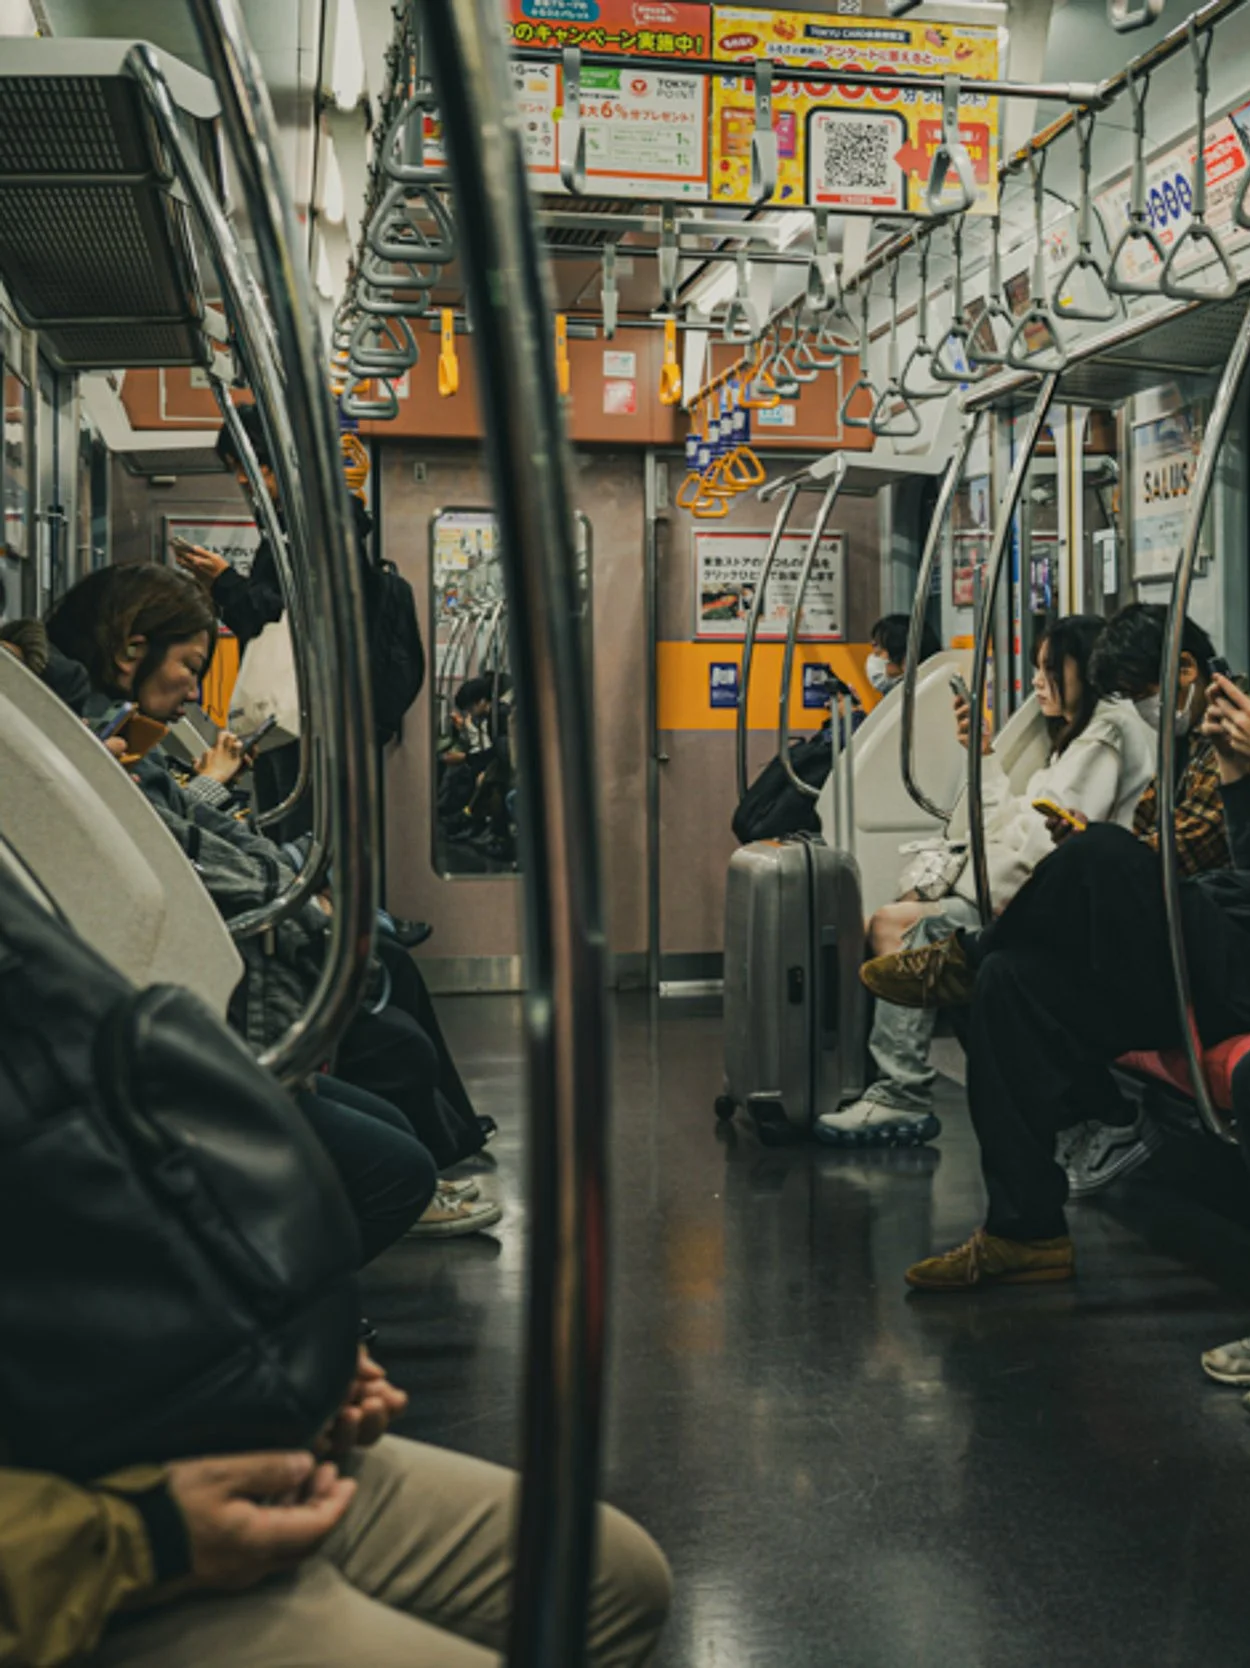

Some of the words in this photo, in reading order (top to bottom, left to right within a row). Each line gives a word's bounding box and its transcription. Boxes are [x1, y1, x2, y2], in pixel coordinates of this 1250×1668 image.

[656, 87, 696, 100] POINT
[1143, 461, 1190, 504] SALUS
[703, 556, 831, 569] 東急ストアのつもの品を
